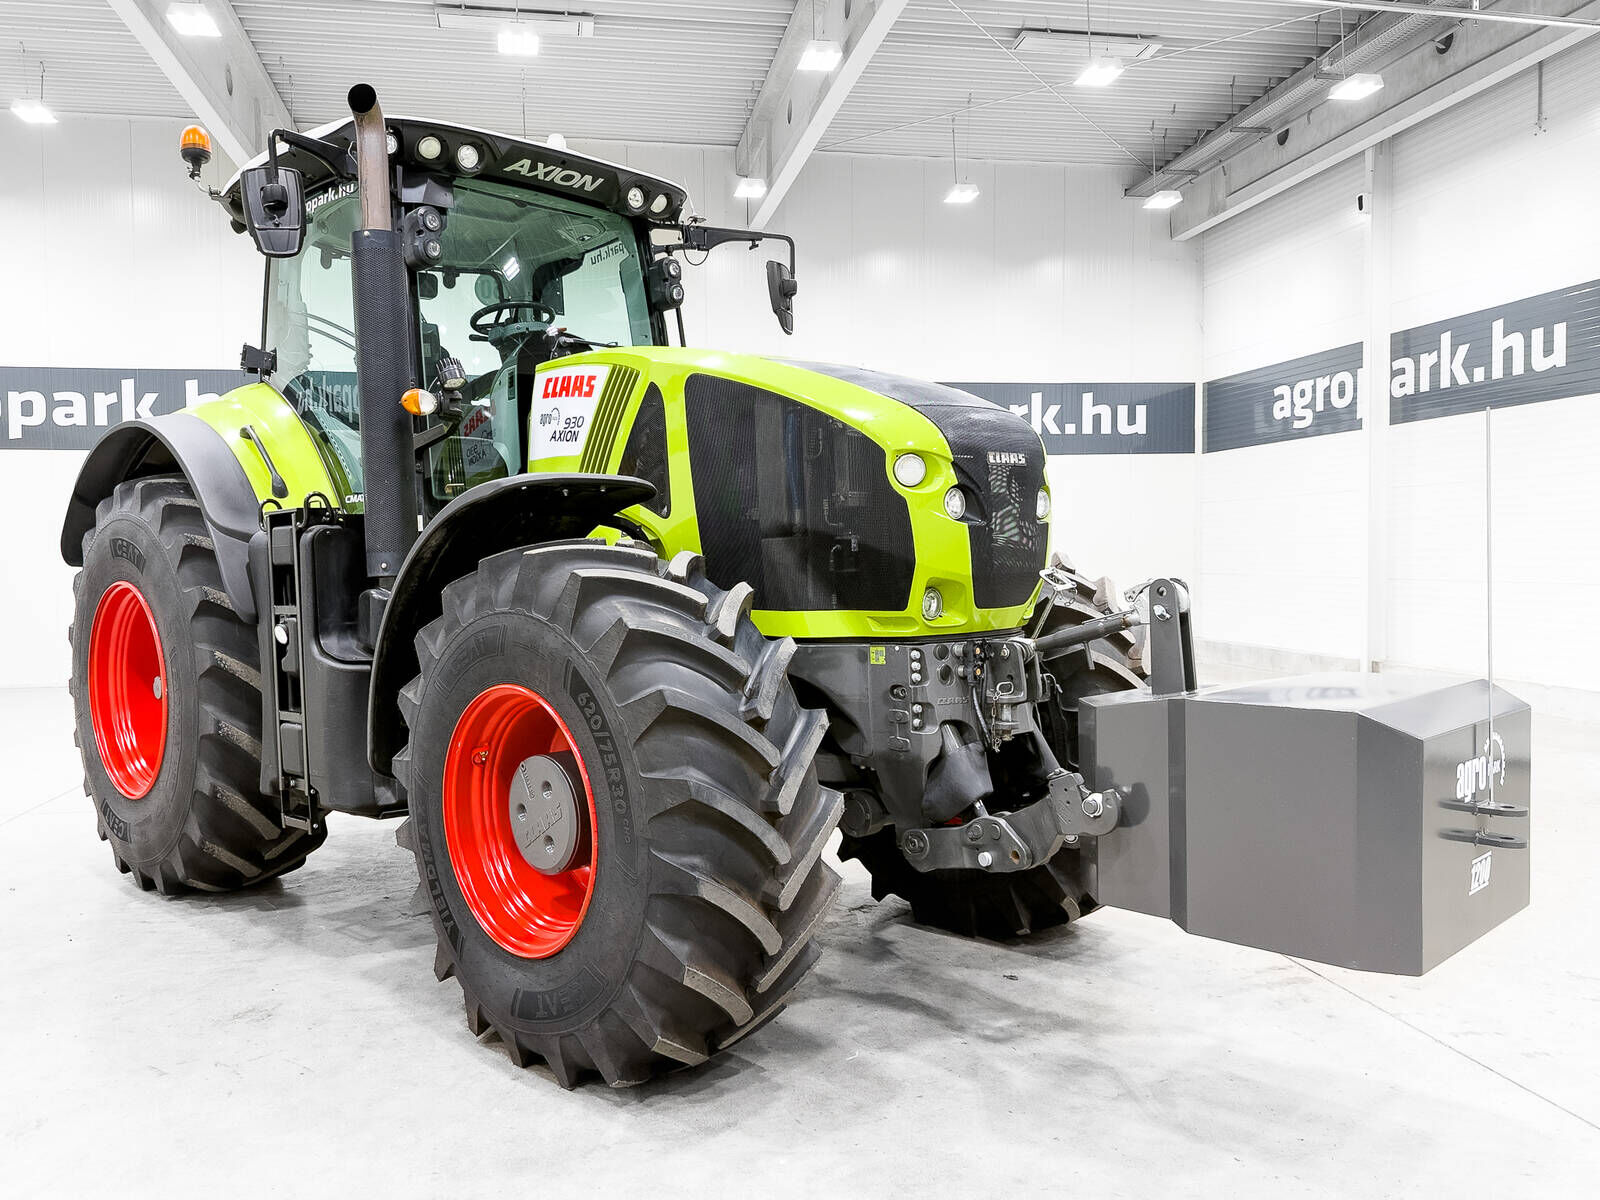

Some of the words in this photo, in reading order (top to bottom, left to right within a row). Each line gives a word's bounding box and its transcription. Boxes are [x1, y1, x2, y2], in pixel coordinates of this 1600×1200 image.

[503, 158, 605, 192] AXION
[542, 375, 597, 399] CLAAS
[563, 416, 585, 429] 930
[549, 430, 580, 442] AXION
[988, 452, 1026, 465] CLAAS
[345, 494, 365, 503] CMA
[1456, 756, 1487, 803] agro
